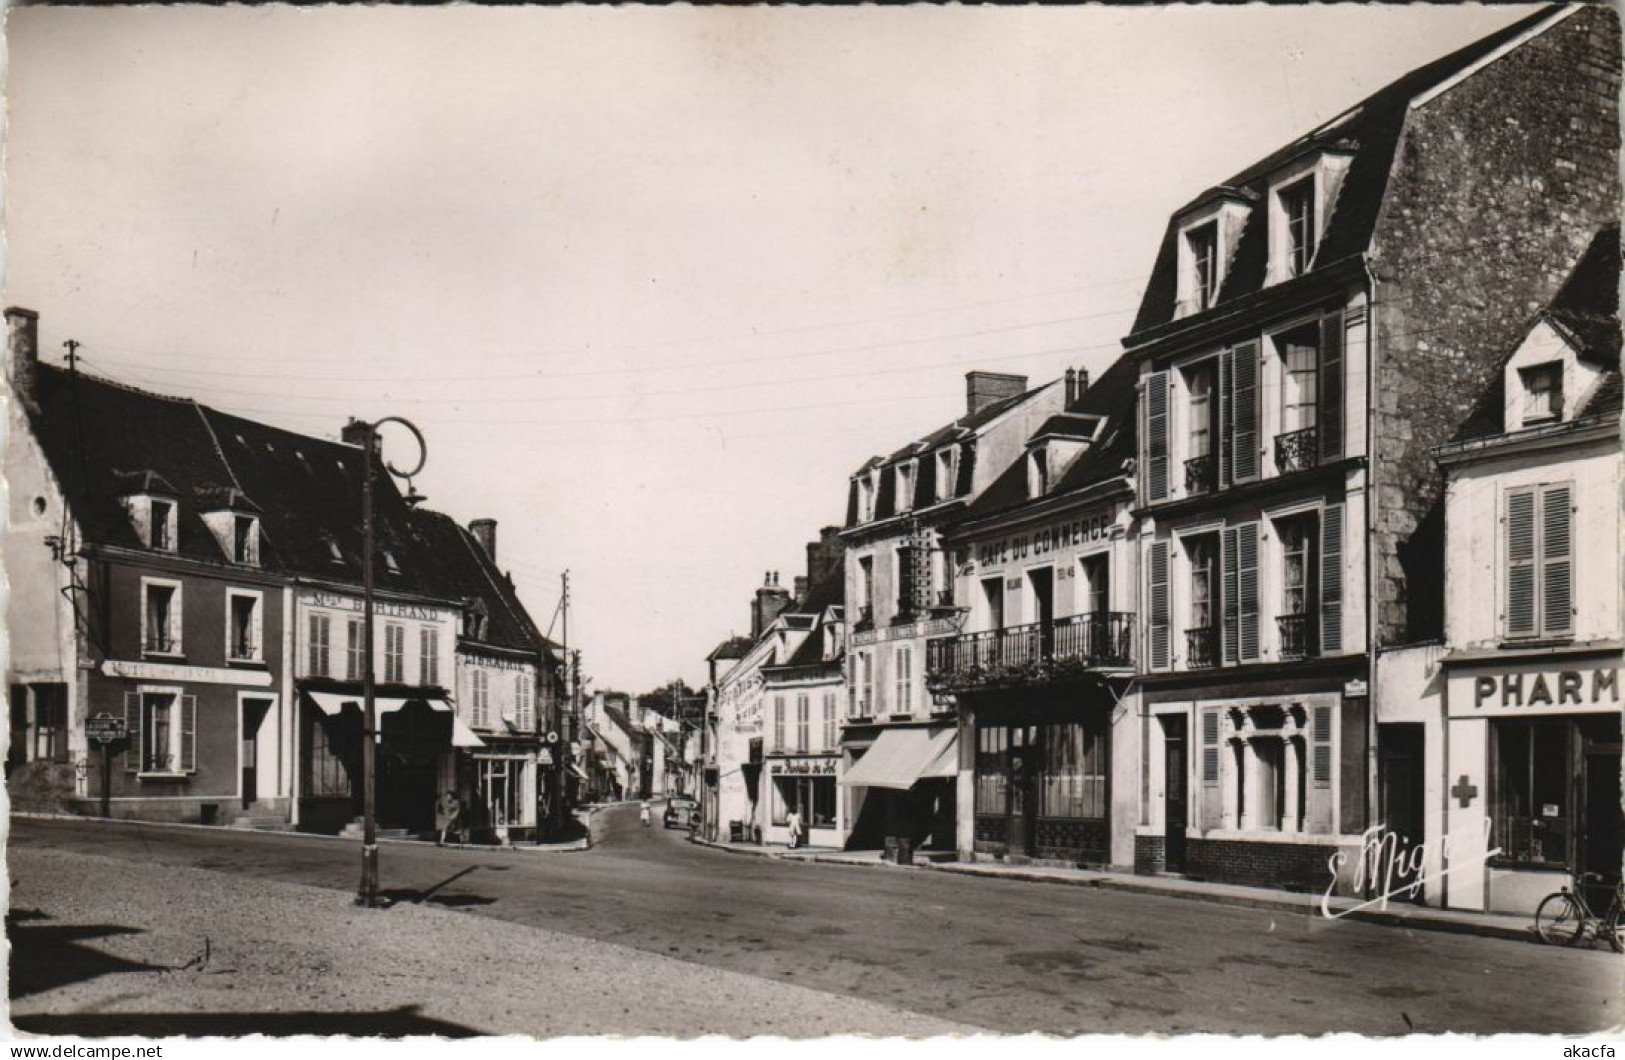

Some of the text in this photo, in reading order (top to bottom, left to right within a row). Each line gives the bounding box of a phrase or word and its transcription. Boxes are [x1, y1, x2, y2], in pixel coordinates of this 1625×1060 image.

[1013, 535, 1028, 560] DU
[1034, 515, 1109, 555] COMMERCE
[353, 599, 438, 620] BRTRAND
[1475, 668, 1619, 708] PHARM
